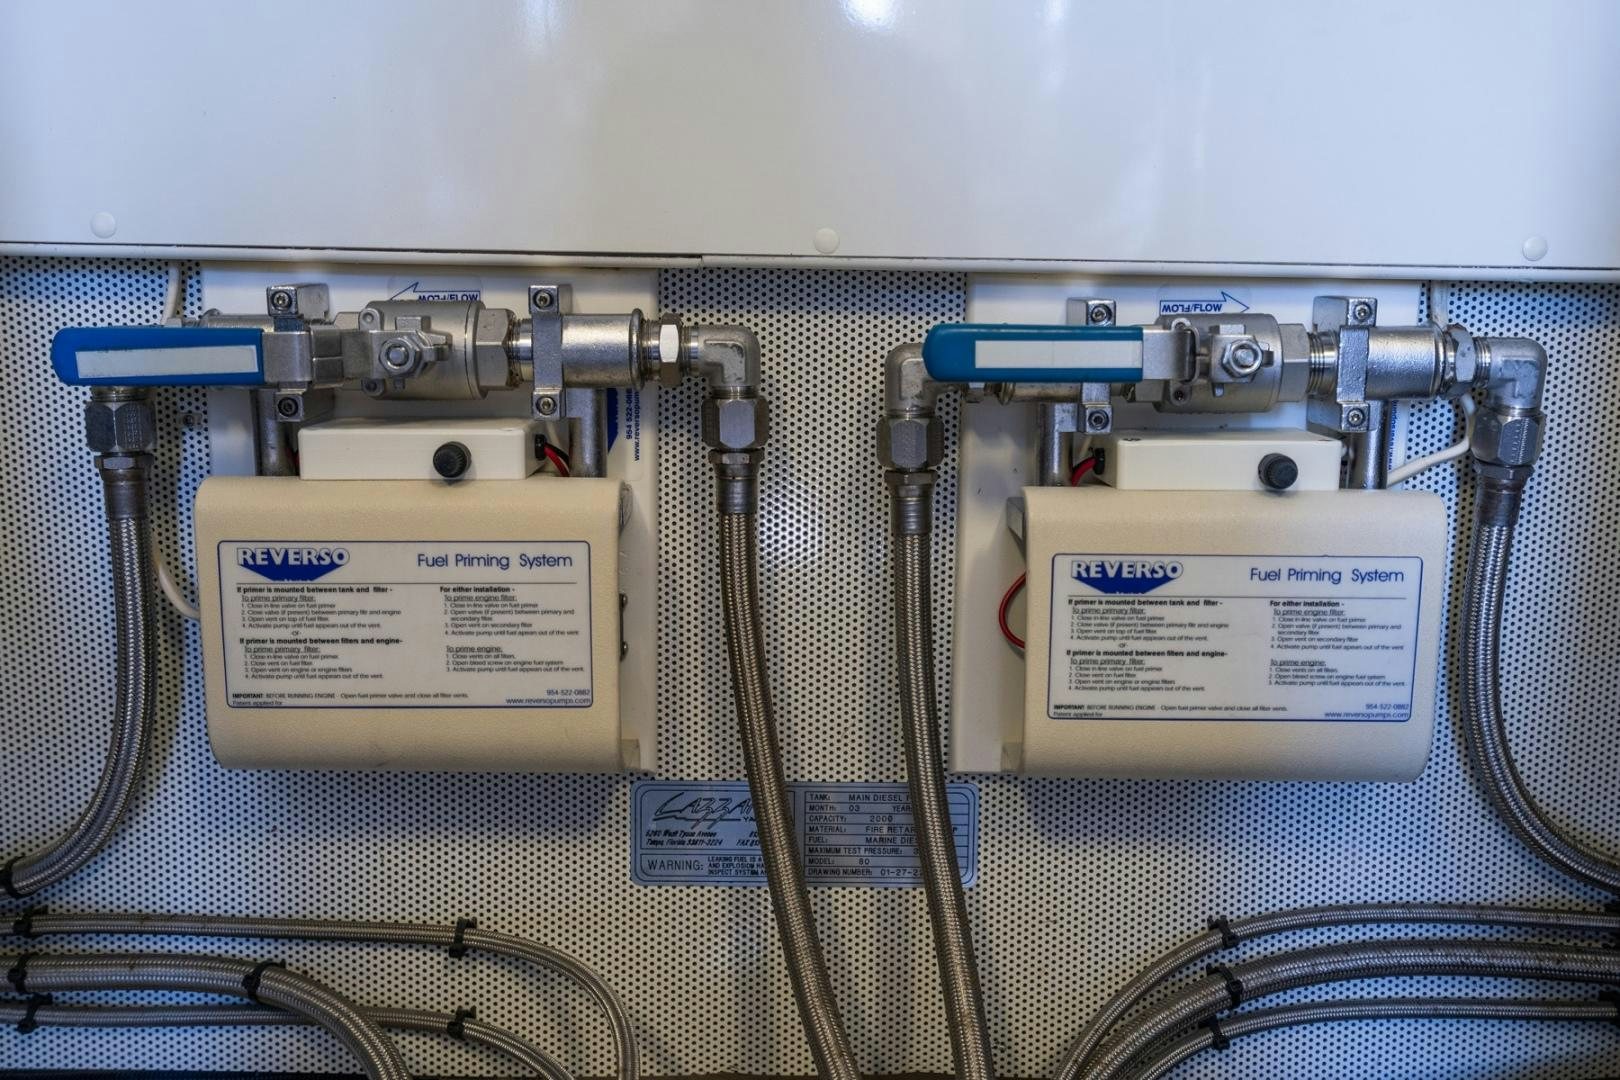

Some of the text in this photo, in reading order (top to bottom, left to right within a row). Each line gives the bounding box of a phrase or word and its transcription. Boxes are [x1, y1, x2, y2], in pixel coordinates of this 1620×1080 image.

[237, 548, 350, 565] REVERSO
[418, 554, 572, 570] Fuel Priming System
[1071, 560, 1183, 578] REVERSO
[1250, 568, 1404, 584] Fuel Priming System
[648, 860, 703, 871] WARNING:
